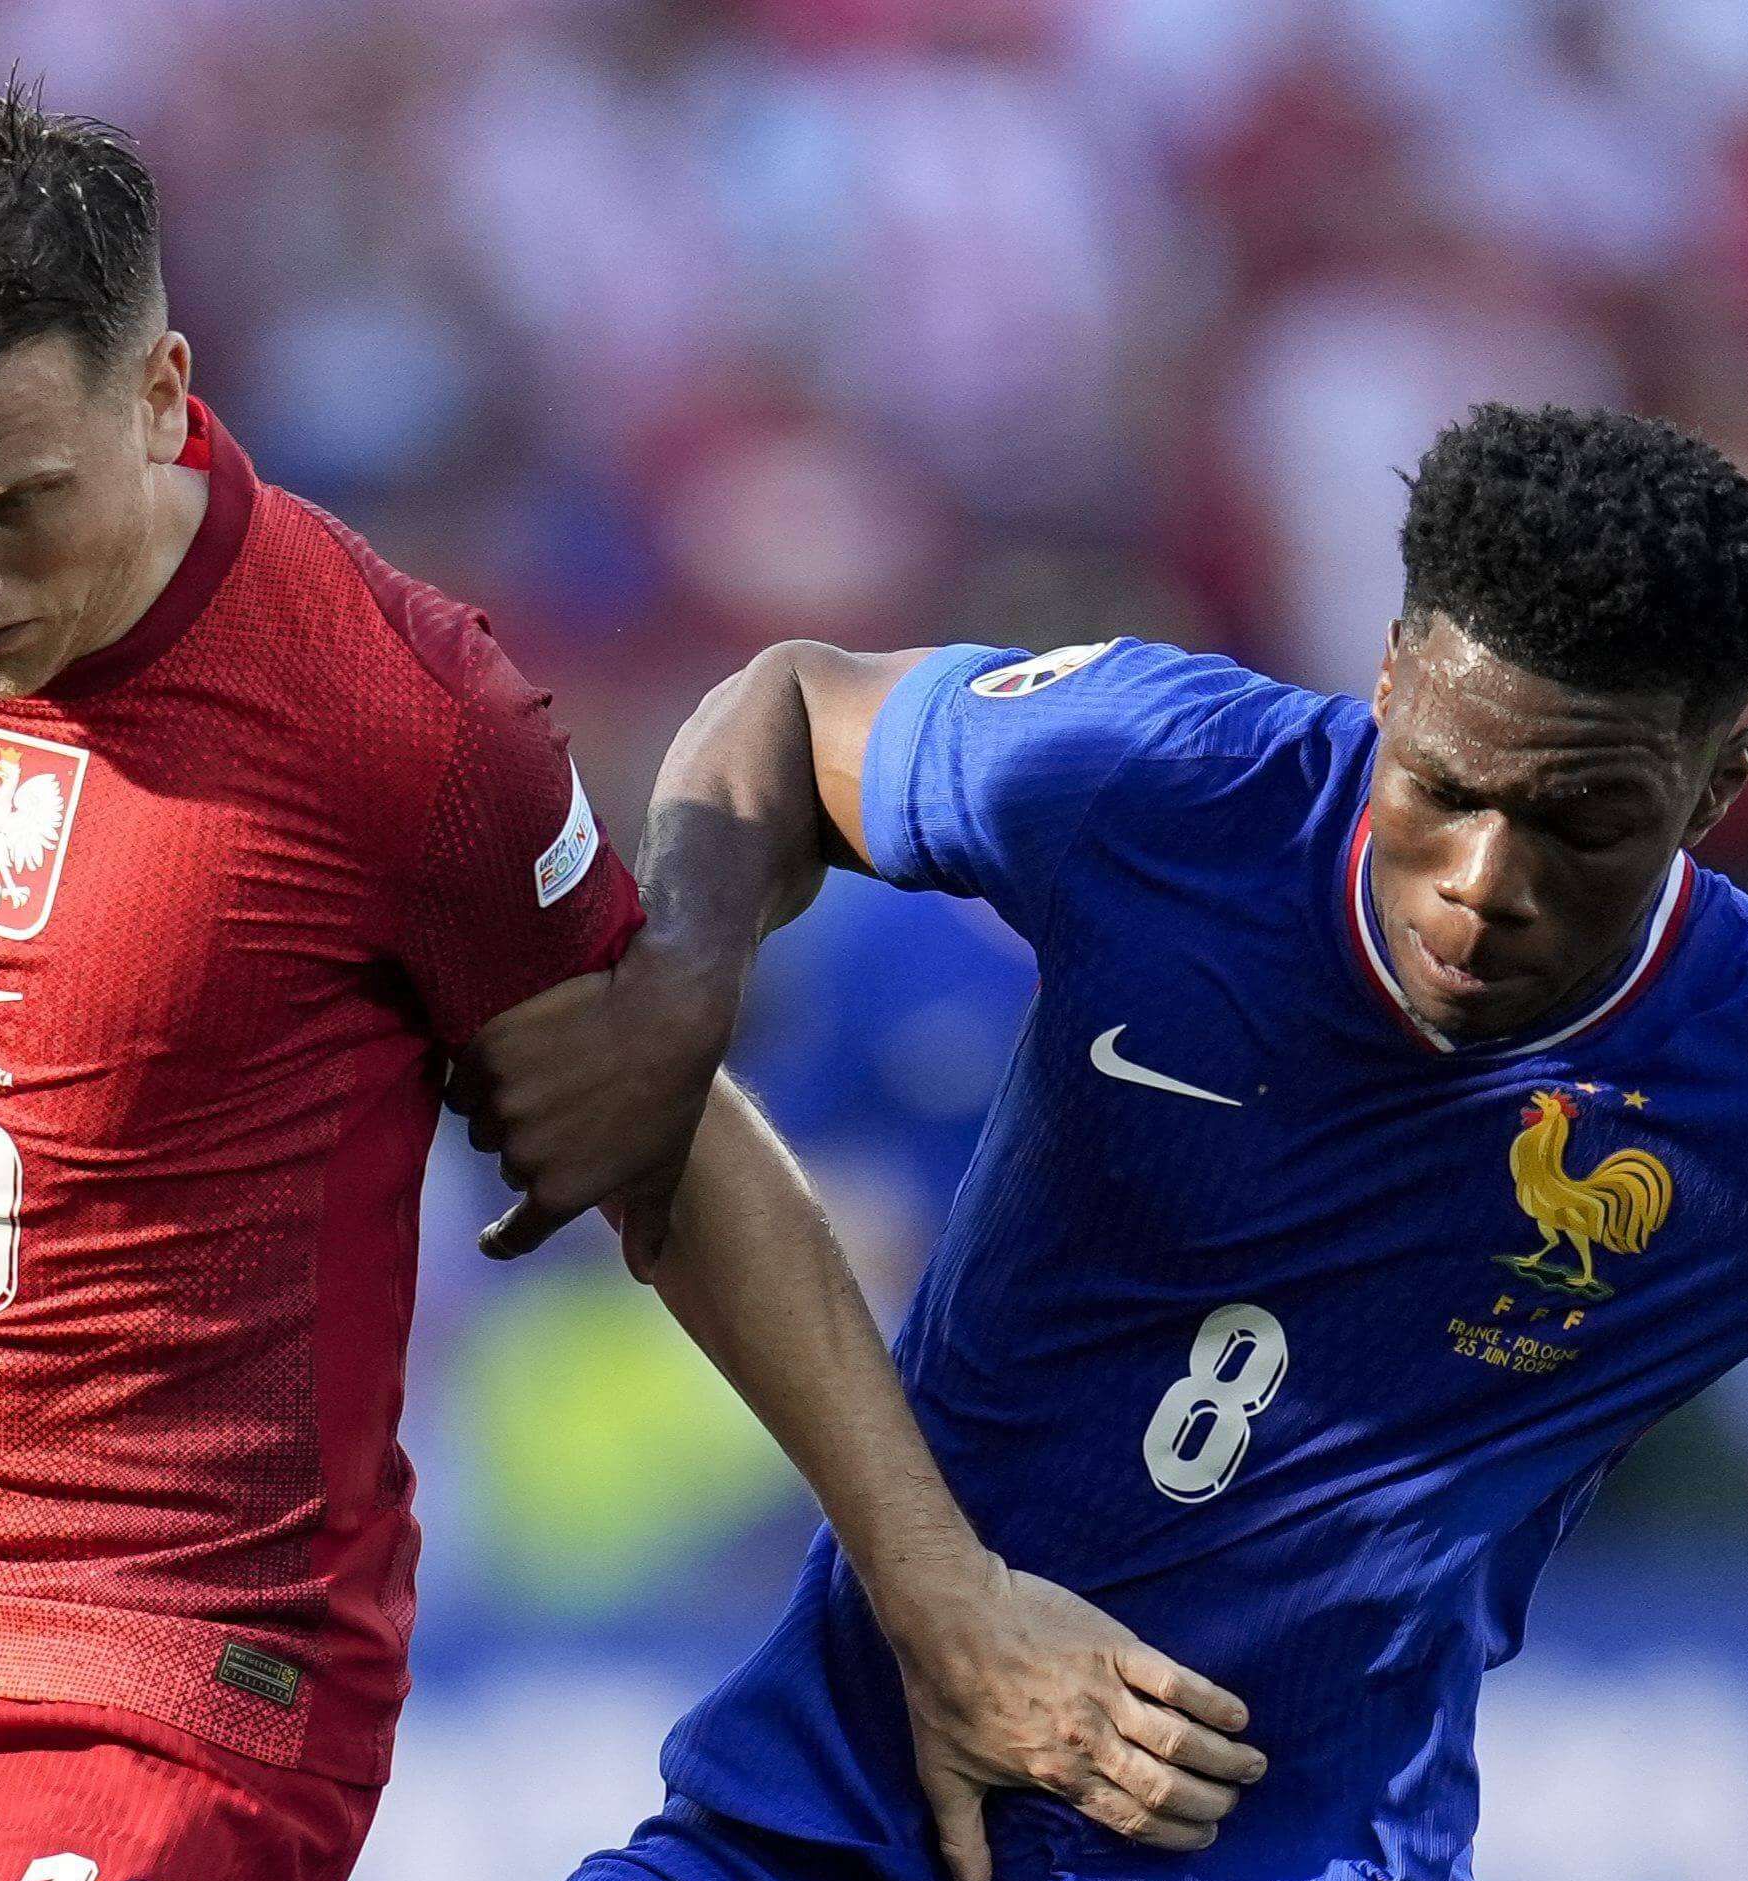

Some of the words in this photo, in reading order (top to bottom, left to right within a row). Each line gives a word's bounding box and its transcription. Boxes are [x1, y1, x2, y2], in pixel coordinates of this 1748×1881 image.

[1447, 1317, 1504, 1346] FRANCE
[1453, 1337, 1479, 1358] 25
[1478, 1344, 1512, 1368] JUIN
[1142, 1303, 1289, 1504] 8
